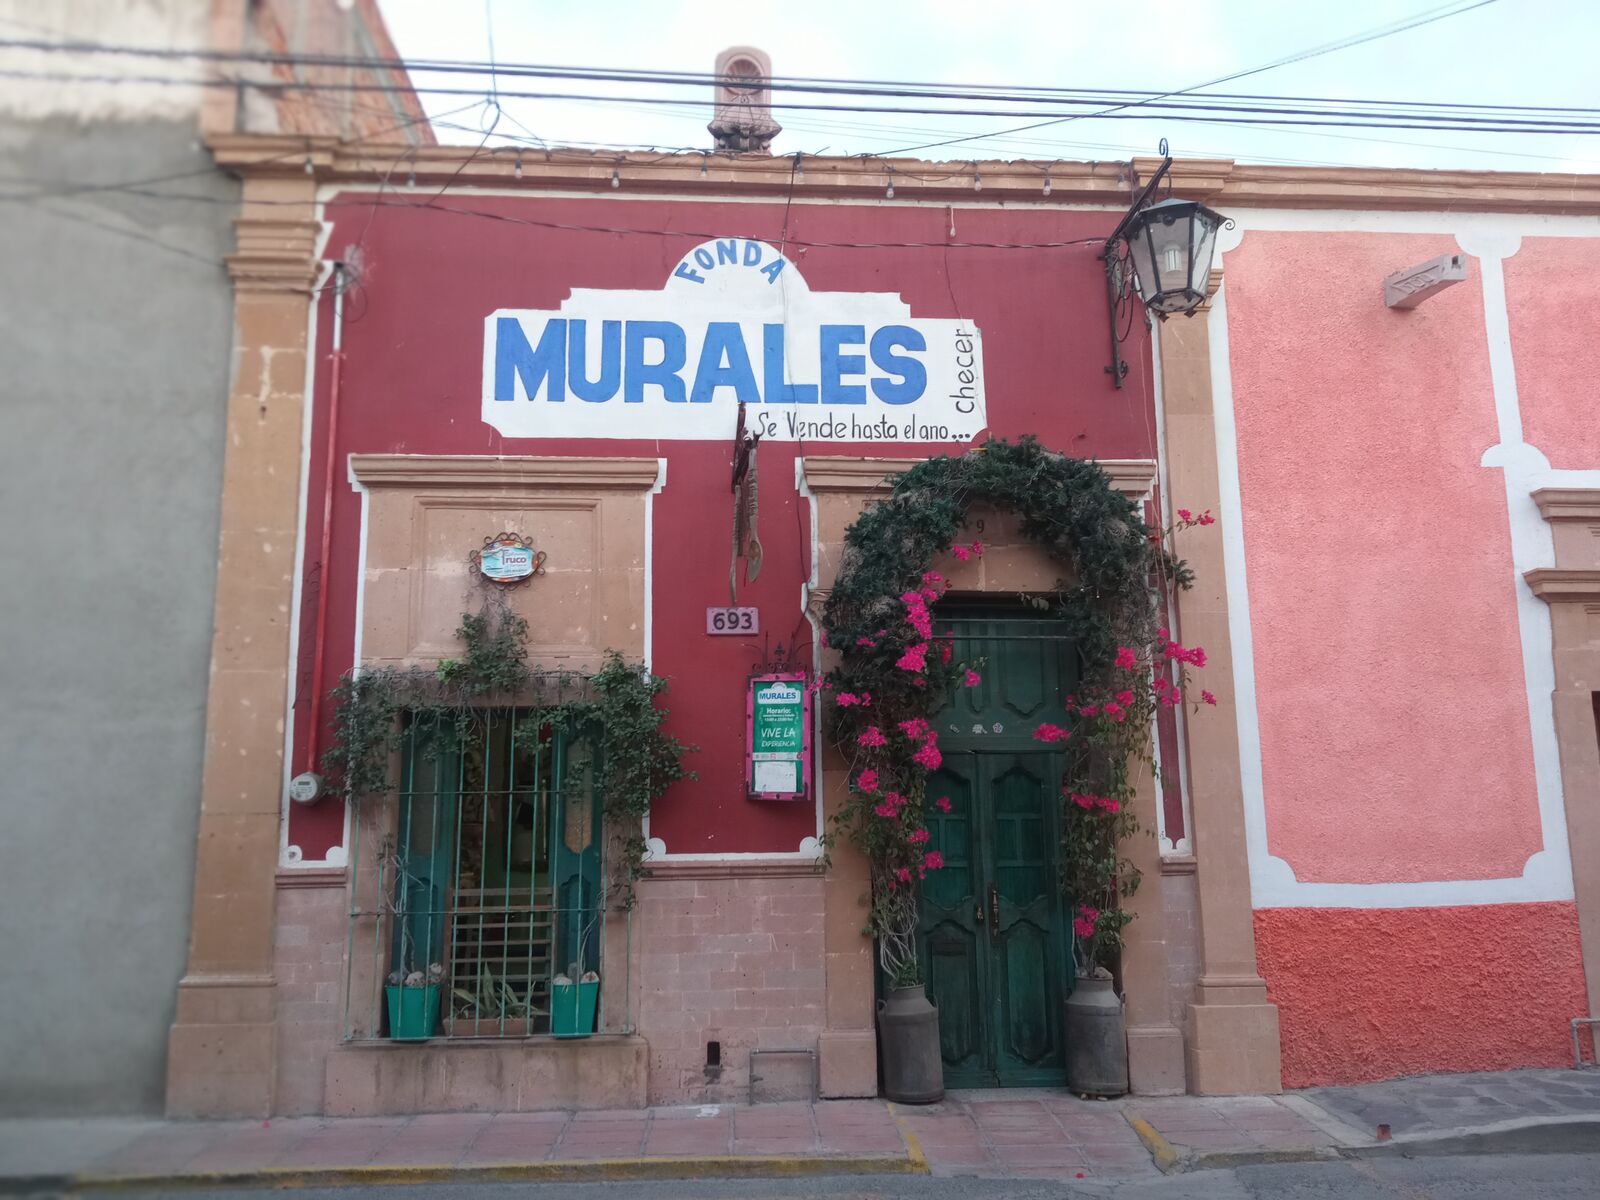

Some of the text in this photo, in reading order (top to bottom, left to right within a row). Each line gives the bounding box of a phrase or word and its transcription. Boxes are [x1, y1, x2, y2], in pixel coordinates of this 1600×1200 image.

[675, 239, 785, 285] FONDA
[494, 317, 927, 405] MURALES
[949, 328, 975, 413] checer
[753, 411, 777, 437] Se
[786, 411, 847, 438] Vende
[852, 412, 898, 440] hasta
[904, 413, 915, 440] el
[713, 612, 753, 630] 693
[759, 692, 797, 700] MURALES
[761, 727, 796, 738] VIVE LA
